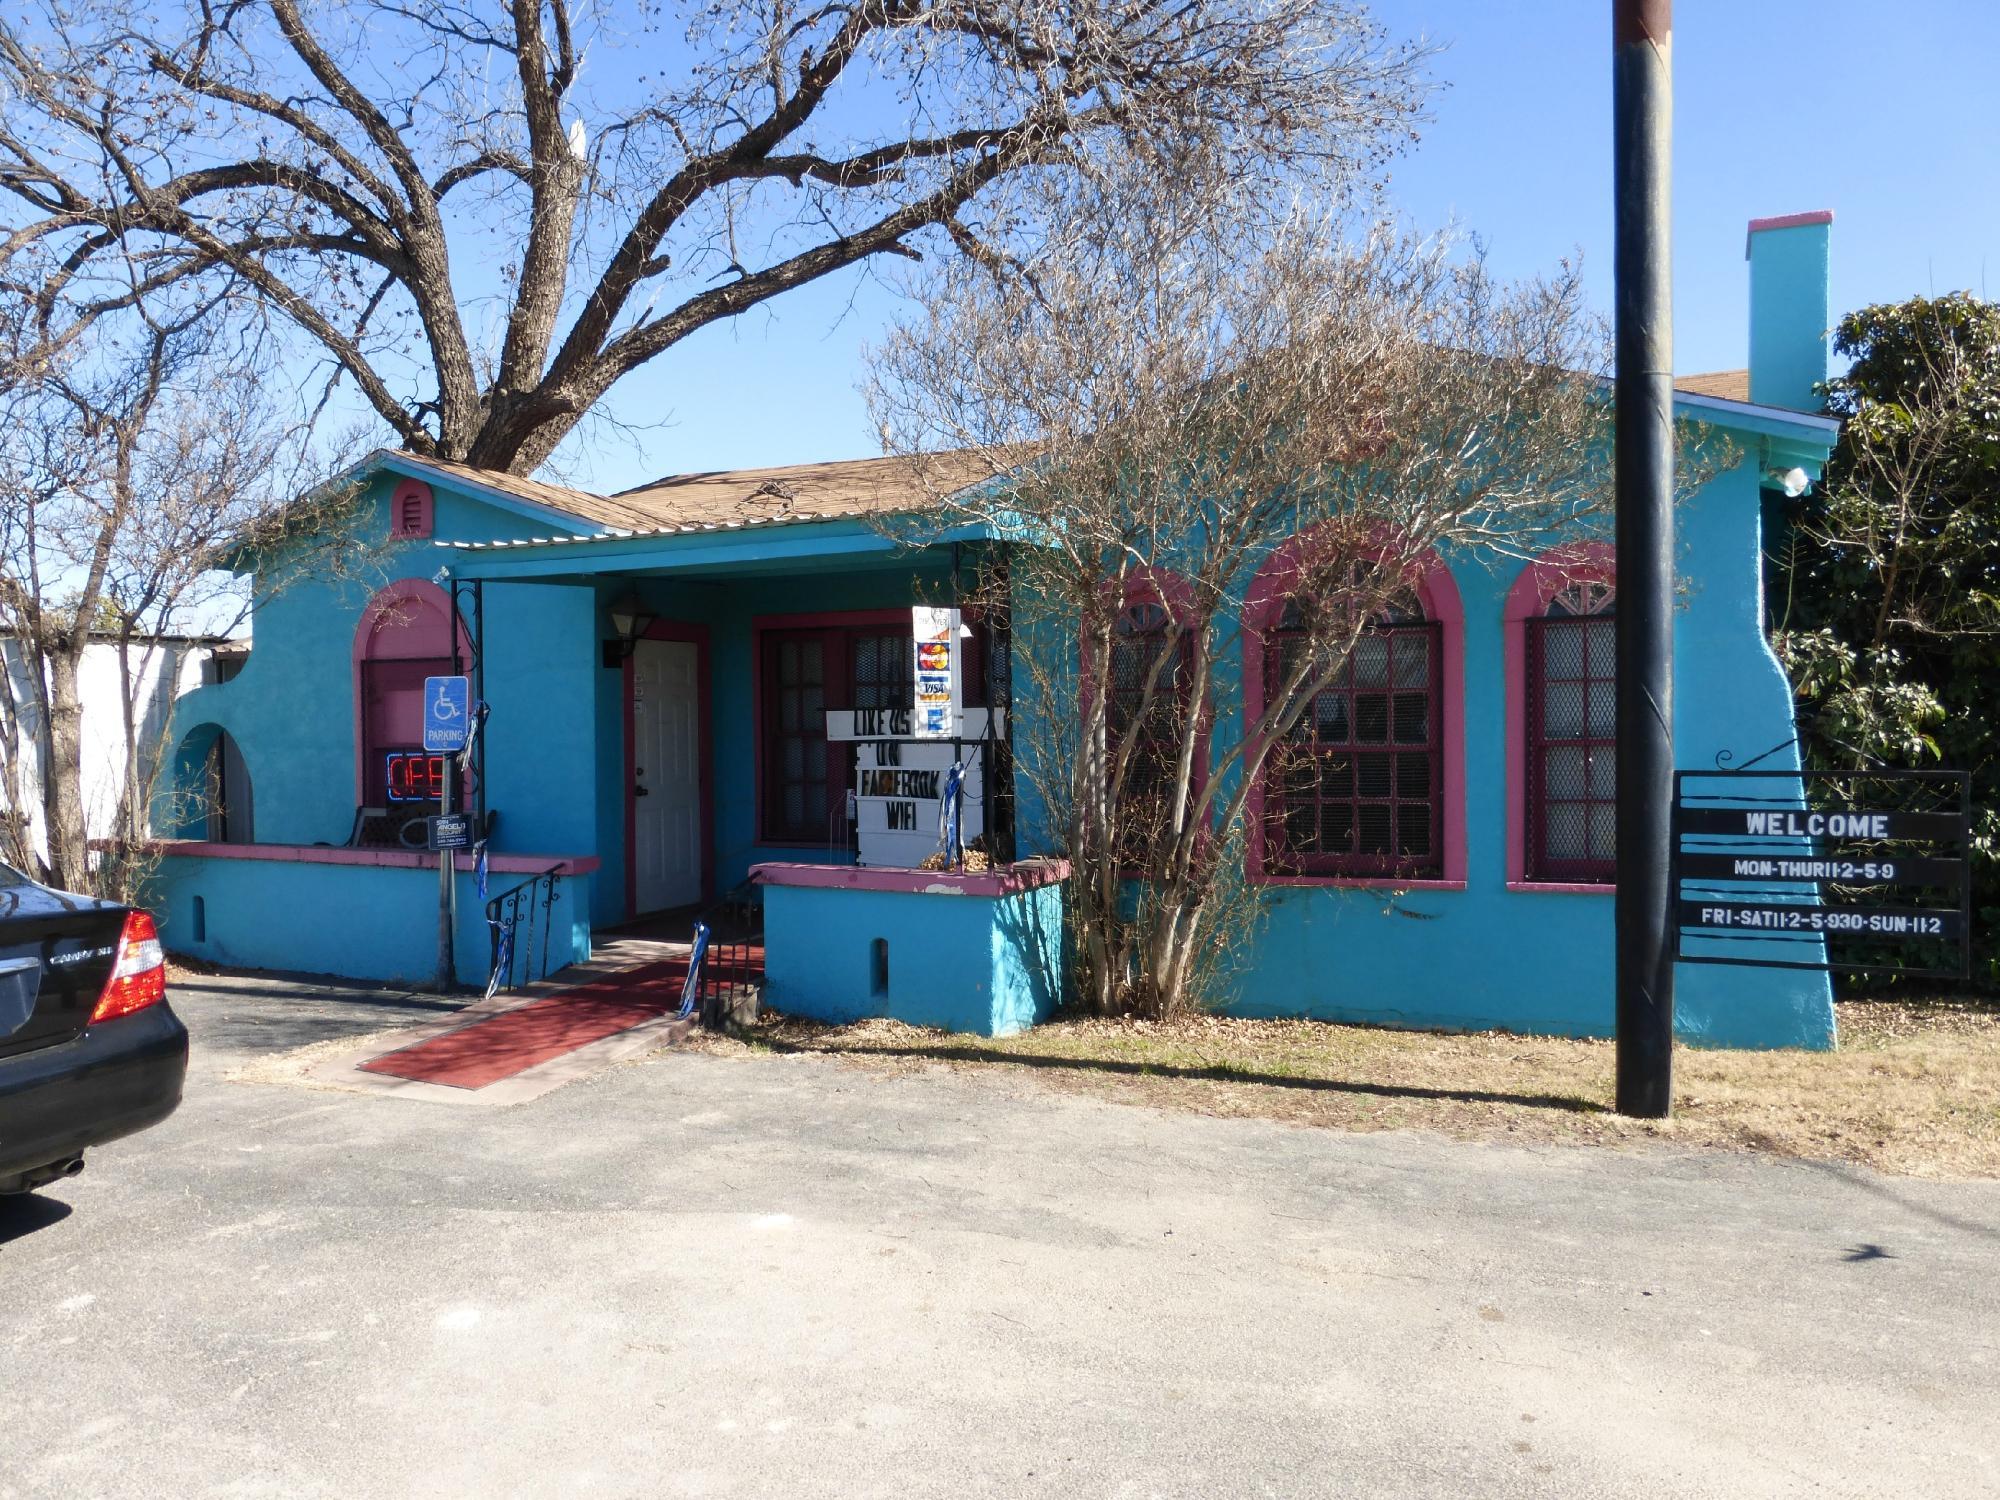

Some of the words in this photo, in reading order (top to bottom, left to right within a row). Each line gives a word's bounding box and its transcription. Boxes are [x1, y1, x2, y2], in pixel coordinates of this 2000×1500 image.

[924, 683, 945, 694] VISA
[428, 730, 463, 741] PARKING
[854, 709, 886, 736] LIKE
[889, 709, 911, 736] US
[876, 743, 901, 766] ON
[390, 757, 444, 796] OPE
[886, 801, 917, 830] WIFI
[1746, 812, 1889, 838] WELCOME
